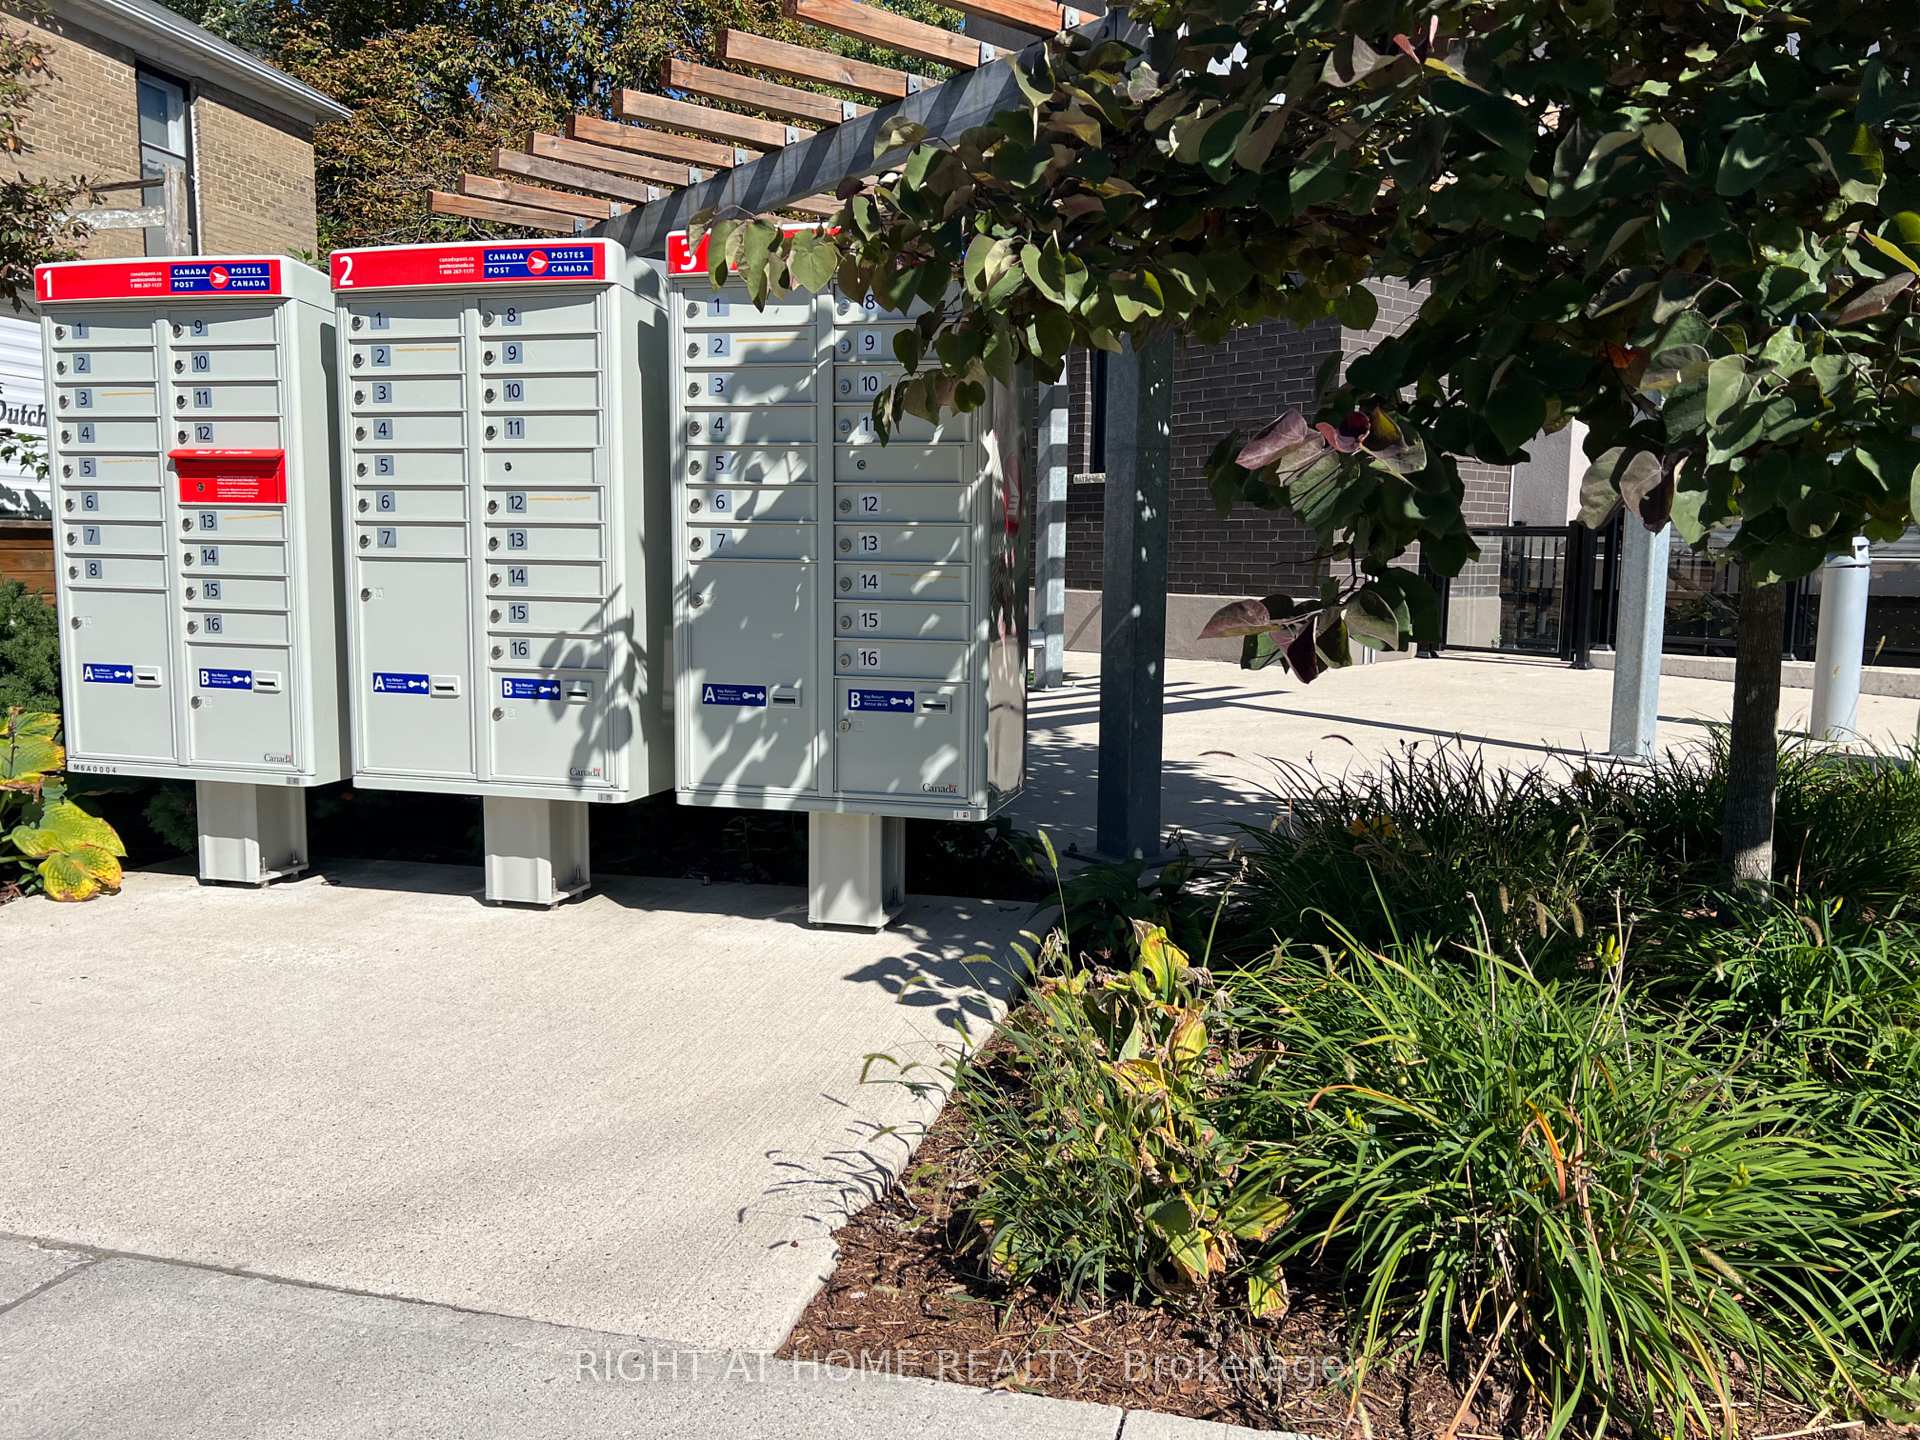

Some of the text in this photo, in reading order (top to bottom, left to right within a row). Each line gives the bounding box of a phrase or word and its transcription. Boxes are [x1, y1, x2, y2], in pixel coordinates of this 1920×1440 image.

[488, 253, 524, 261] CANADA
[551, 251, 584, 259] POSTES
[680, 239, 697, 270] 3
[174, 268, 207, 276] CANADA
[339, 256, 353, 286] 2
[42, 270, 53, 298] 1
[713, 297, 720, 313] 1
[865, 294, 875, 310] 8
[375, 311, 382, 326] 1
[507, 307, 516, 323] 8
[76, 322, 82, 336] 1
[194, 319, 203, 334] 9
[714, 338, 723, 354] 2
[864, 334, 875, 351] 9
[376, 348, 385, 363] 2
[507, 345, 517, 361] 9
[77, 357, 86, 371] 2
[193, 355, 207, 370] 10
[506, 383, 521, 398] 10
[714, 377, 724, 393] 3
[861, 375, 878, 392] 10
[80, 391, 88, 406] 3
[196, 391, 208, 405] 11
[378, 385, 387, 400] 3
[378, 422, 387, 436] 4
[508, 420, 520, 435] 11
[713, 417, 725, 432] 4
[81, 426, 90, 440] 4
[197, 426, 211, 440] 12
[83, 460, 91, 474] 5
[380, 458, 388, 473] 5
[715, 455, 725, 471] 5
[86, 495, 94, 509] 6
[381, 494, 390, 509] 6
[509, 495, 523, 510] 12
[715, 494, 726, 510] 6
[862, 496, 878, 512] 12
[201, 514, 214, 529] 13
[87, 528, 95, 542] 7
[382, 530, 391, 545] 7
[509, 532, 524, 547] 13
[716, 533, 726, 549] 7
[861, 535, 878, 551] 13
[202, 549, 217, 563] 14
[89, 562, 98, 576] 8
[510, 569, 525, 583] 14
[861, 574, 879, 589] 14
[204, 583, 218, 597] 15
[511, 605, 526, 620] 15
[861, 612, 878, 628] 15
[206, 617, 220, 631] 16
[511, 641, 528, 656] 16
[860, 651, 878, 666] 16
[84, 666, 94, 680] A
[201, 671, 209, 686] B
[374, 675, 385, 690] A
[504, 681, 512, 696] B
[704, 686, 715, 702] A
[851, 692, 860, 707] B
[264, 753, 291, 763] Canada
[570, 768, 601, 777] Canada
[922, 784, 957, 794] Canada
